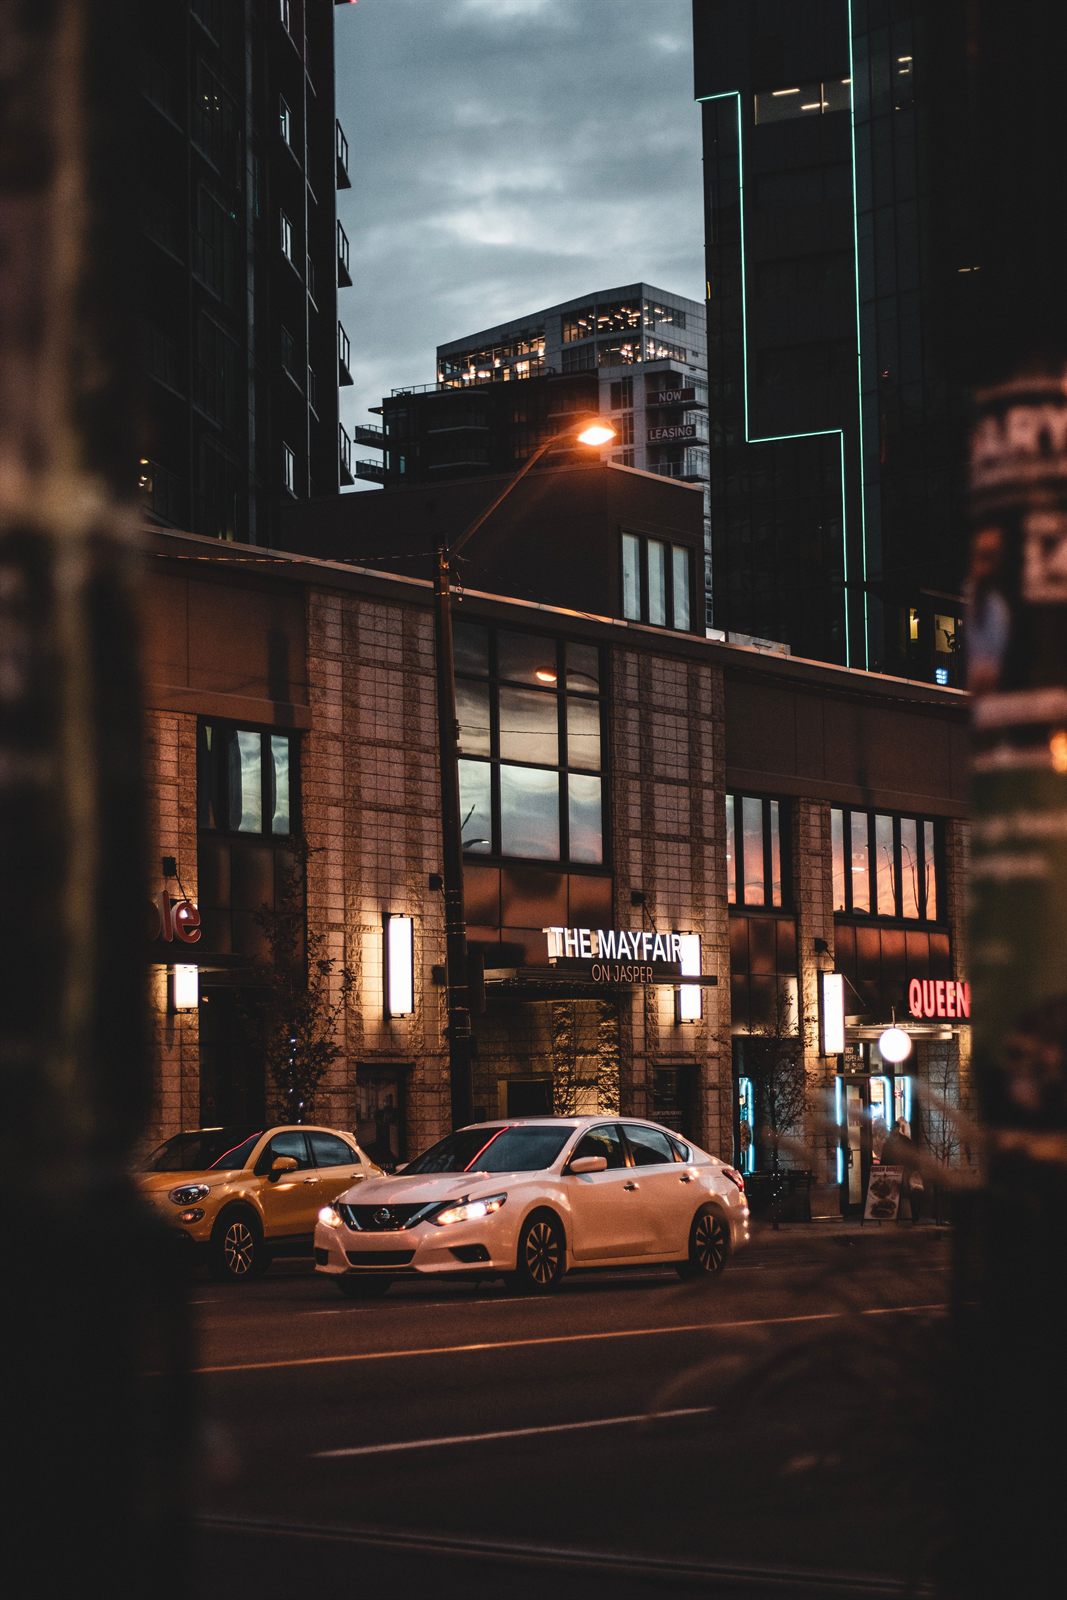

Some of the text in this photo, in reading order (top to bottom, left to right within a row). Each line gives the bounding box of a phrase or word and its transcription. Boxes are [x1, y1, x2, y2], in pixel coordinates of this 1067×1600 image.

[659, 390, 682, 402] NOW
[650, 426, 693, 440] LEASING
[543, 926, 682, 963] THE MAYFAIR
[592, 964, 653, 983] ON JASPER
[909, 978, 970, 1018] QUEEN
